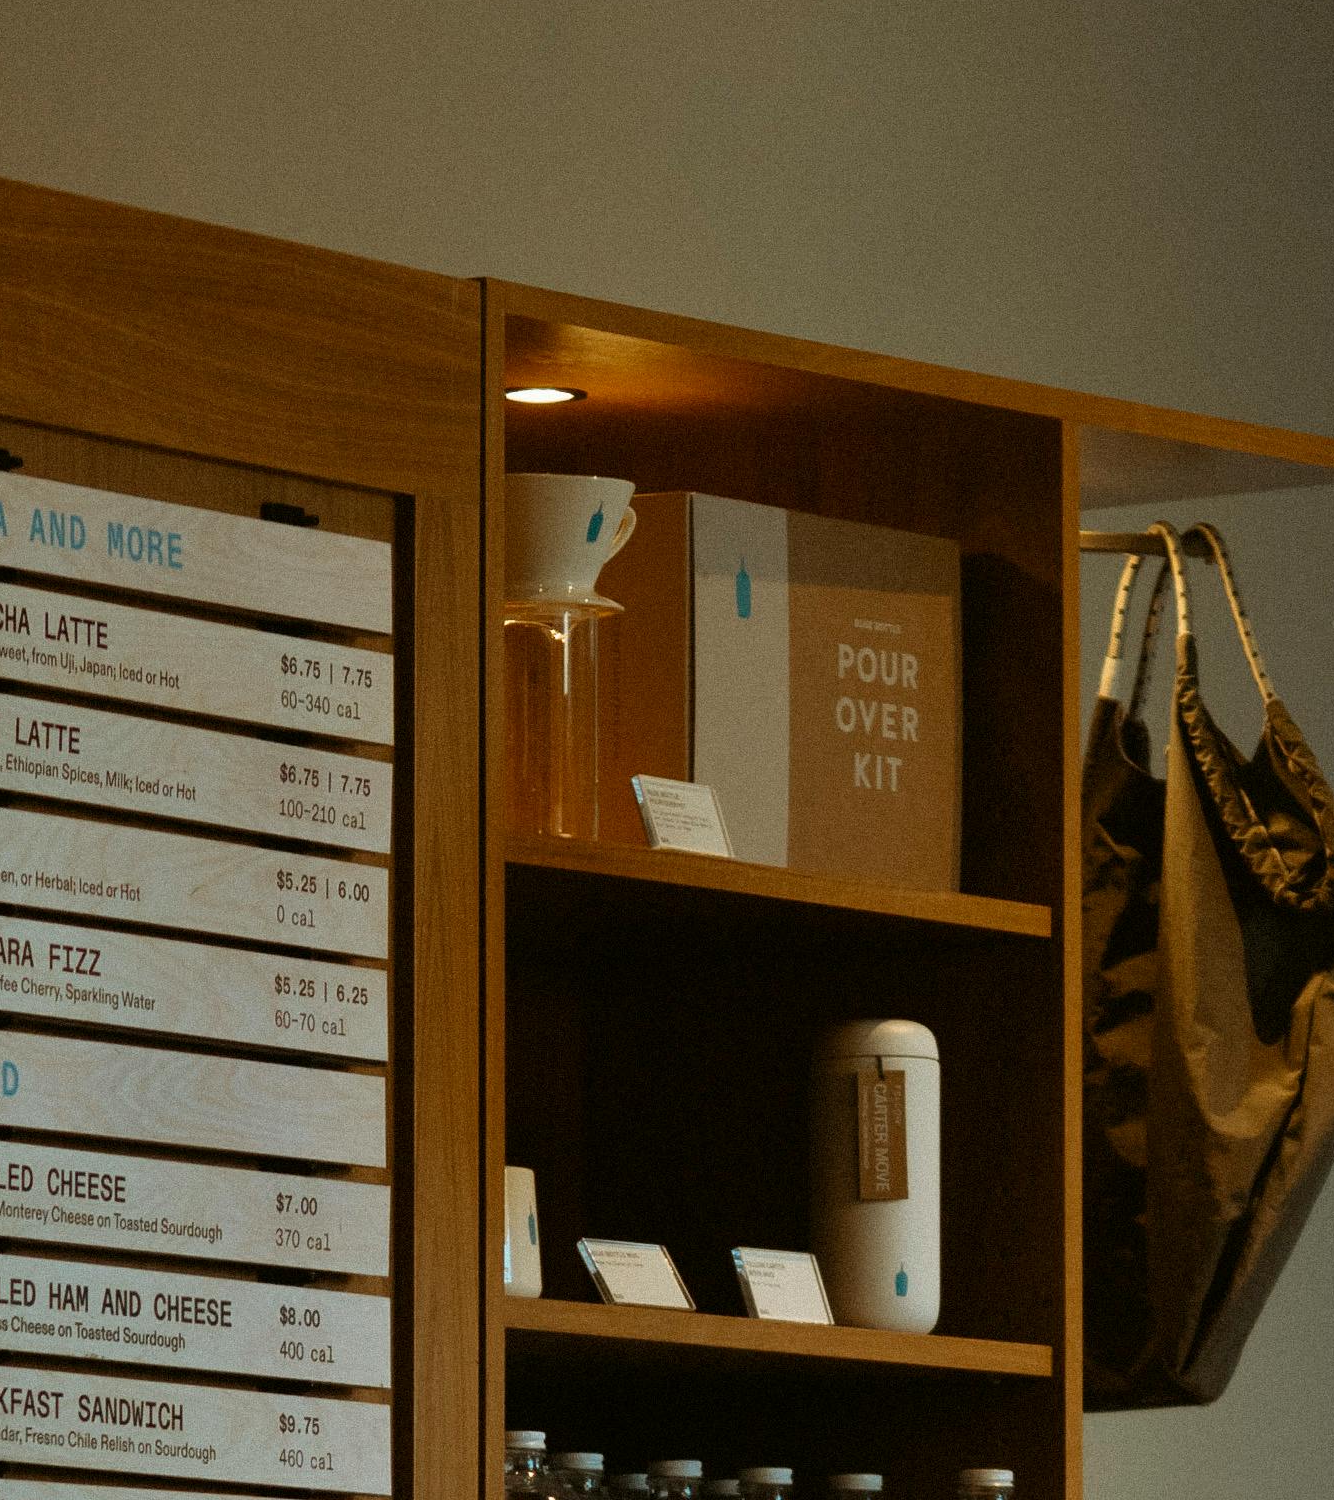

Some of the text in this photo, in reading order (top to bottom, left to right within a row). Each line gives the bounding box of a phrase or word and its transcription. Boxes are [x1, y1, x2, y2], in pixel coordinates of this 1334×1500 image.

[28, 508, 87, 550] AND
[106, 522, 183, 569] MORE
[44, 612, 108, 649] LATTE
[280, 653, 372, 688] $6.75 7.75
[837, 643, 918, 690] POUR
[14, 717, 81, 754] LATTE
[835, 696, 919, 743] OVER
[4, 752, 59, 778] Ethiopian
[60, 762, 103, 787] Spices,
[104, 770, 133, 793] Milk;
[134, 775, 160, 795] Iced
[161, 783, 174, 797] or
[175, 782, 196, 801] Hot
[278, 762, 371, 797] $6.75 7.75
[853, 752, 903, 793] KIT
[19, 872, 33, 886] or
[34, 871, 76, 894] Herbal;
[78, 878, 104, 897] Iced
[104, 885, 118, 898] or
[118, 882, 141, 901] Hot
[275, 868, 370, 902] $5.25 6.00
[48, 943, 101, 976] FIZZ
[20, 976, 63, 1001] Cherry,
[64, 982, 119, 1010] Sparkling
[120, 990, 155, 1010] Water
[273, 973, 368, 1005] $5.25 6.25
[873, 1083, 891, 1192] CARTER MOVE
[46, 1167, 126, 1203] CHEESE
[275, 1192, 318, 1216] $7.00
[50, 1204, 95, 1226] Cheese
[96, 1214, 111, 1228] on
[112, 1212, 158, 1233] Toasted
[159, 1217, 223, 1244] Sourdough
[275, 1228, 331, 1251] 370 cal
[48, 1282, 89, 1312] HAM
[100, 1287, 141, 1317] AND
[152, 1293, 232, 1327] CHEESE
[278, 1304, 321, 1328] $8.00
[9, 1315, 55, 1336] Cheese
[56, 1323, 73, 1337] on
[73, 1321, 121, 1342] Toasted
[122, 1326, 186, 1352] Sourdough
[279, 1342, 335, 1365] 400 cal
[77, 1394, 183, 1430] SANDWICH
[278, 1412, 320, 1435] $9.75
[24, 1426, 65, 1447] Fresno
[66, 1429, 98, 1449] Chile
[99, 1433, 135, 1452] Relish
[136, 1441, 152, 1454] on
[154, 1438, 217, 1464] Sourdough
